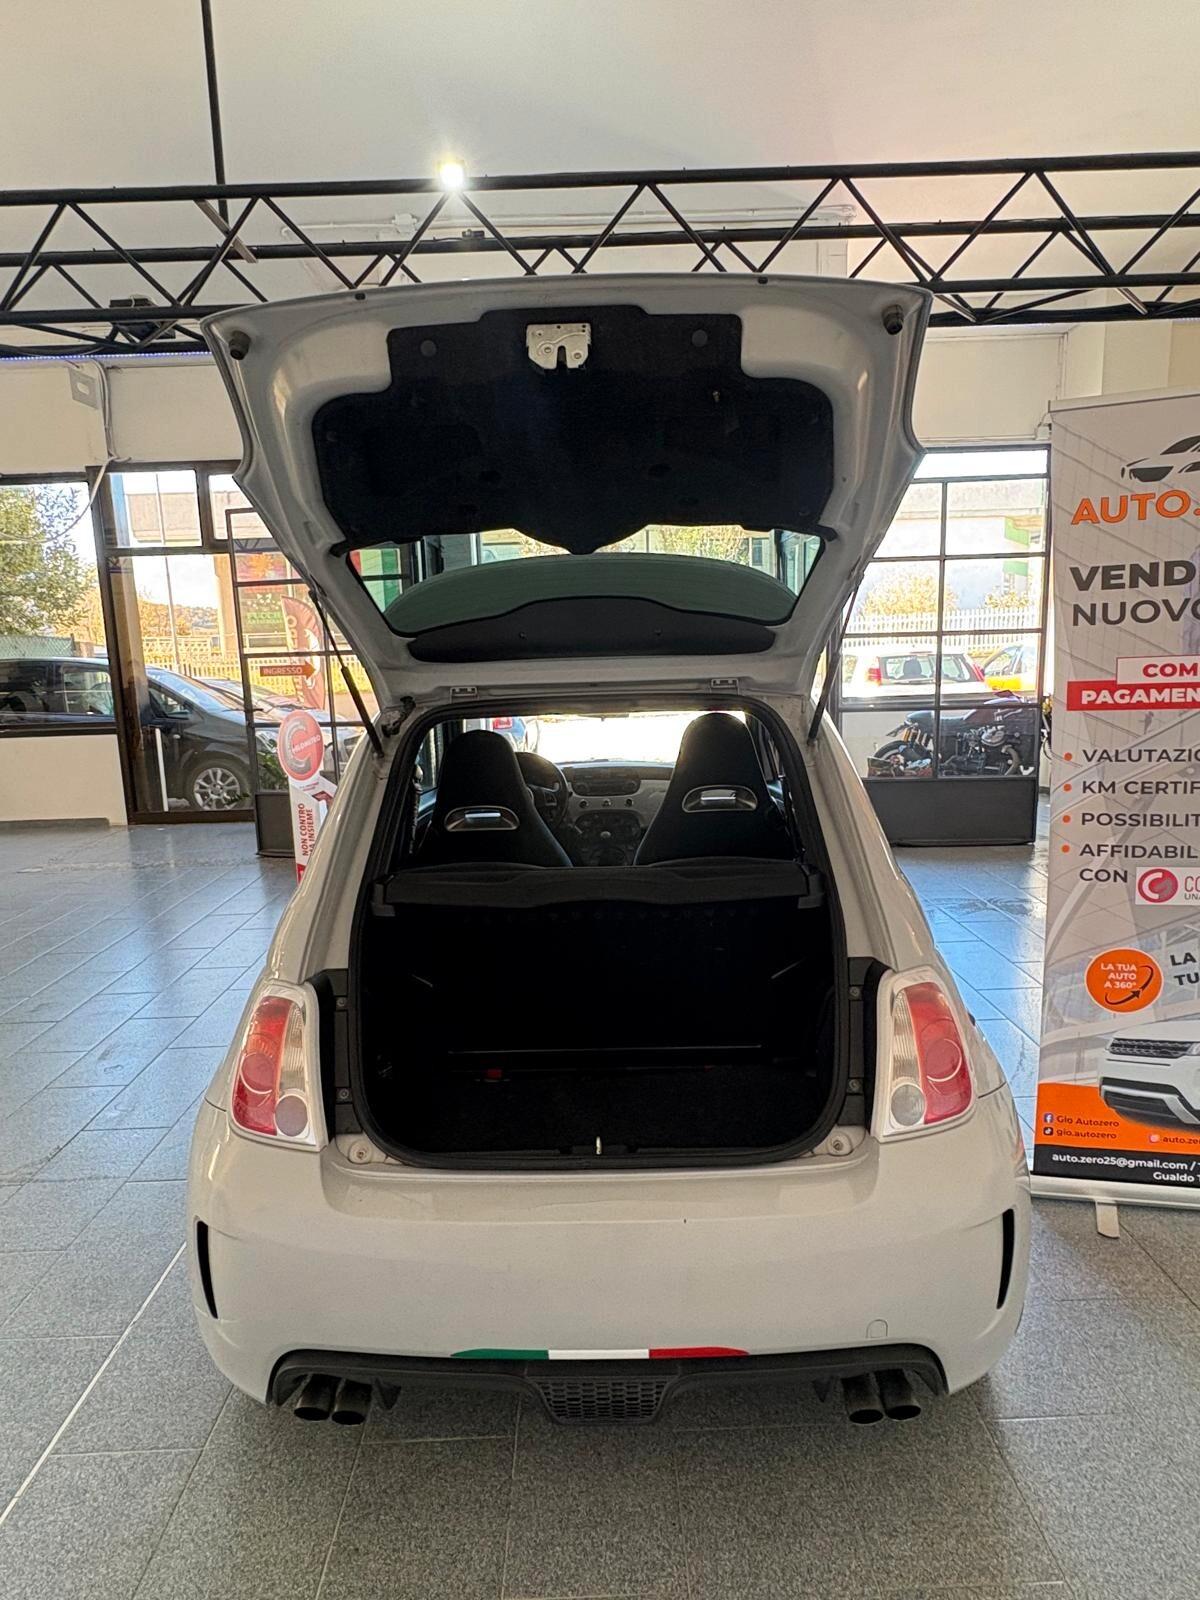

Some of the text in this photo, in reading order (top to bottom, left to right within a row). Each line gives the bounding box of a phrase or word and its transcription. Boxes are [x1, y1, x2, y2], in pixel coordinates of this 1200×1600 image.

[263, 666, 303, 675] INGRESSO
[1082, 780, 1116, 795] KM
[297, 803, 309, 857] NON CONTRO
[306, 808, 315, 842] INSIEME
[1079, 843, 1199, 859] AFFIDABIL
[1079, 868, 1128, 883] CON
[1169, 952, 1197, 967] LA
[1100, 963, 1137, 971] LA TUA
[1108, 972, 1137, 980] AUTO
[1103, 981, 1112, 989] A
[1056, 1115, 1120, 1128] Gio Autozero
[1056, 1128, 1117, 1139] gio.autozero
[1052, 1153, 1188, 1170] auto.zero25@gmail.com
[1153, 1171, 1195, 1183] Gualdo
